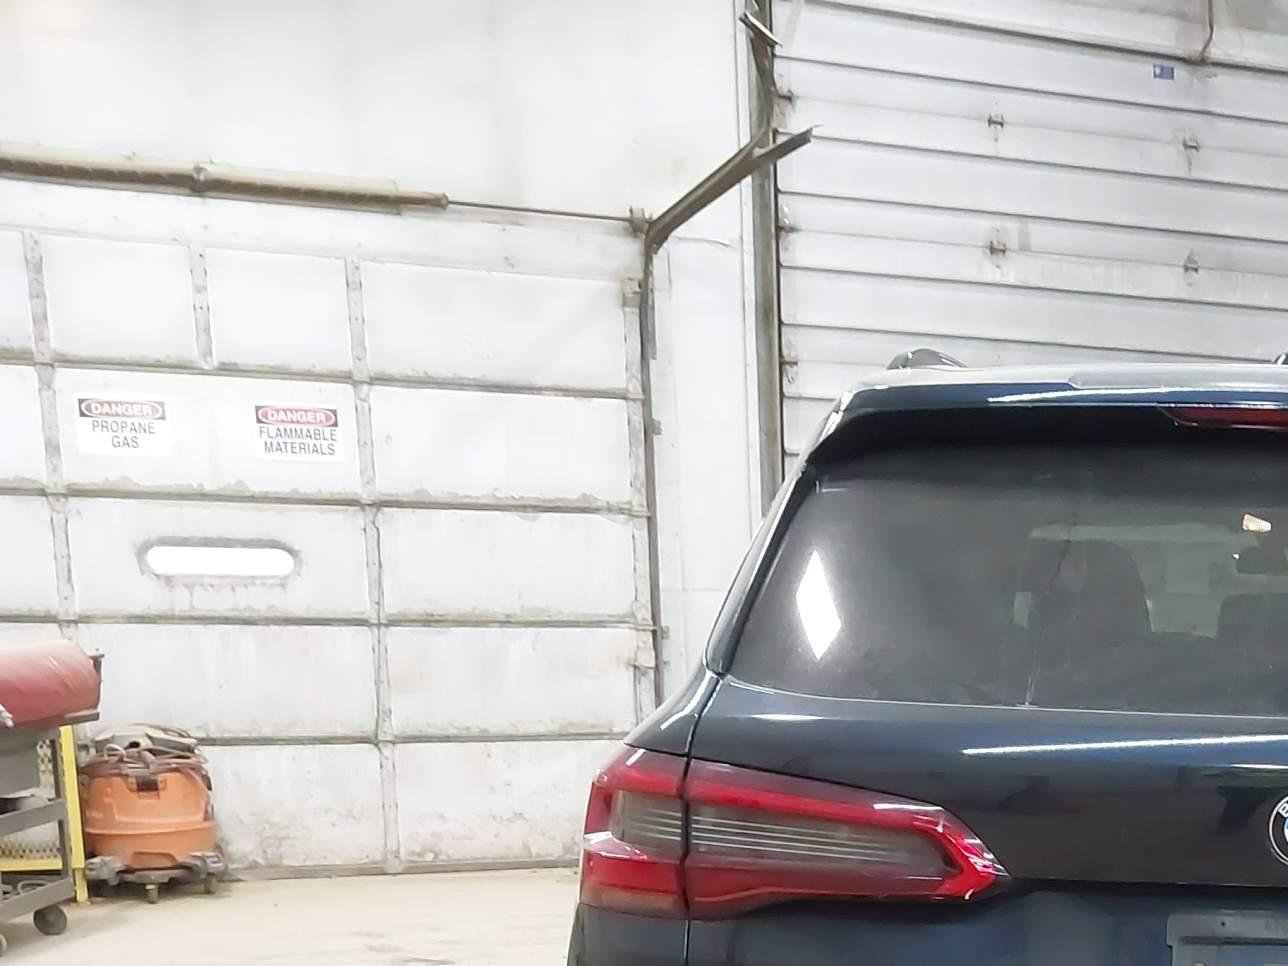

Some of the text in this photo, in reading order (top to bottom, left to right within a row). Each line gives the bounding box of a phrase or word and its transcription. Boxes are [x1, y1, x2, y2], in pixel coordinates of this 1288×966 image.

[90, 401, 153, 417] DANGER
[267, 410, 327, 424] DANGER
[91, 419, 156, 435] PROPANE
[258, 426, 338, 442] FLAMMABLE
[111, 435, 140, 449] GAS
[263, 441, 336, 456] MATERIALS
